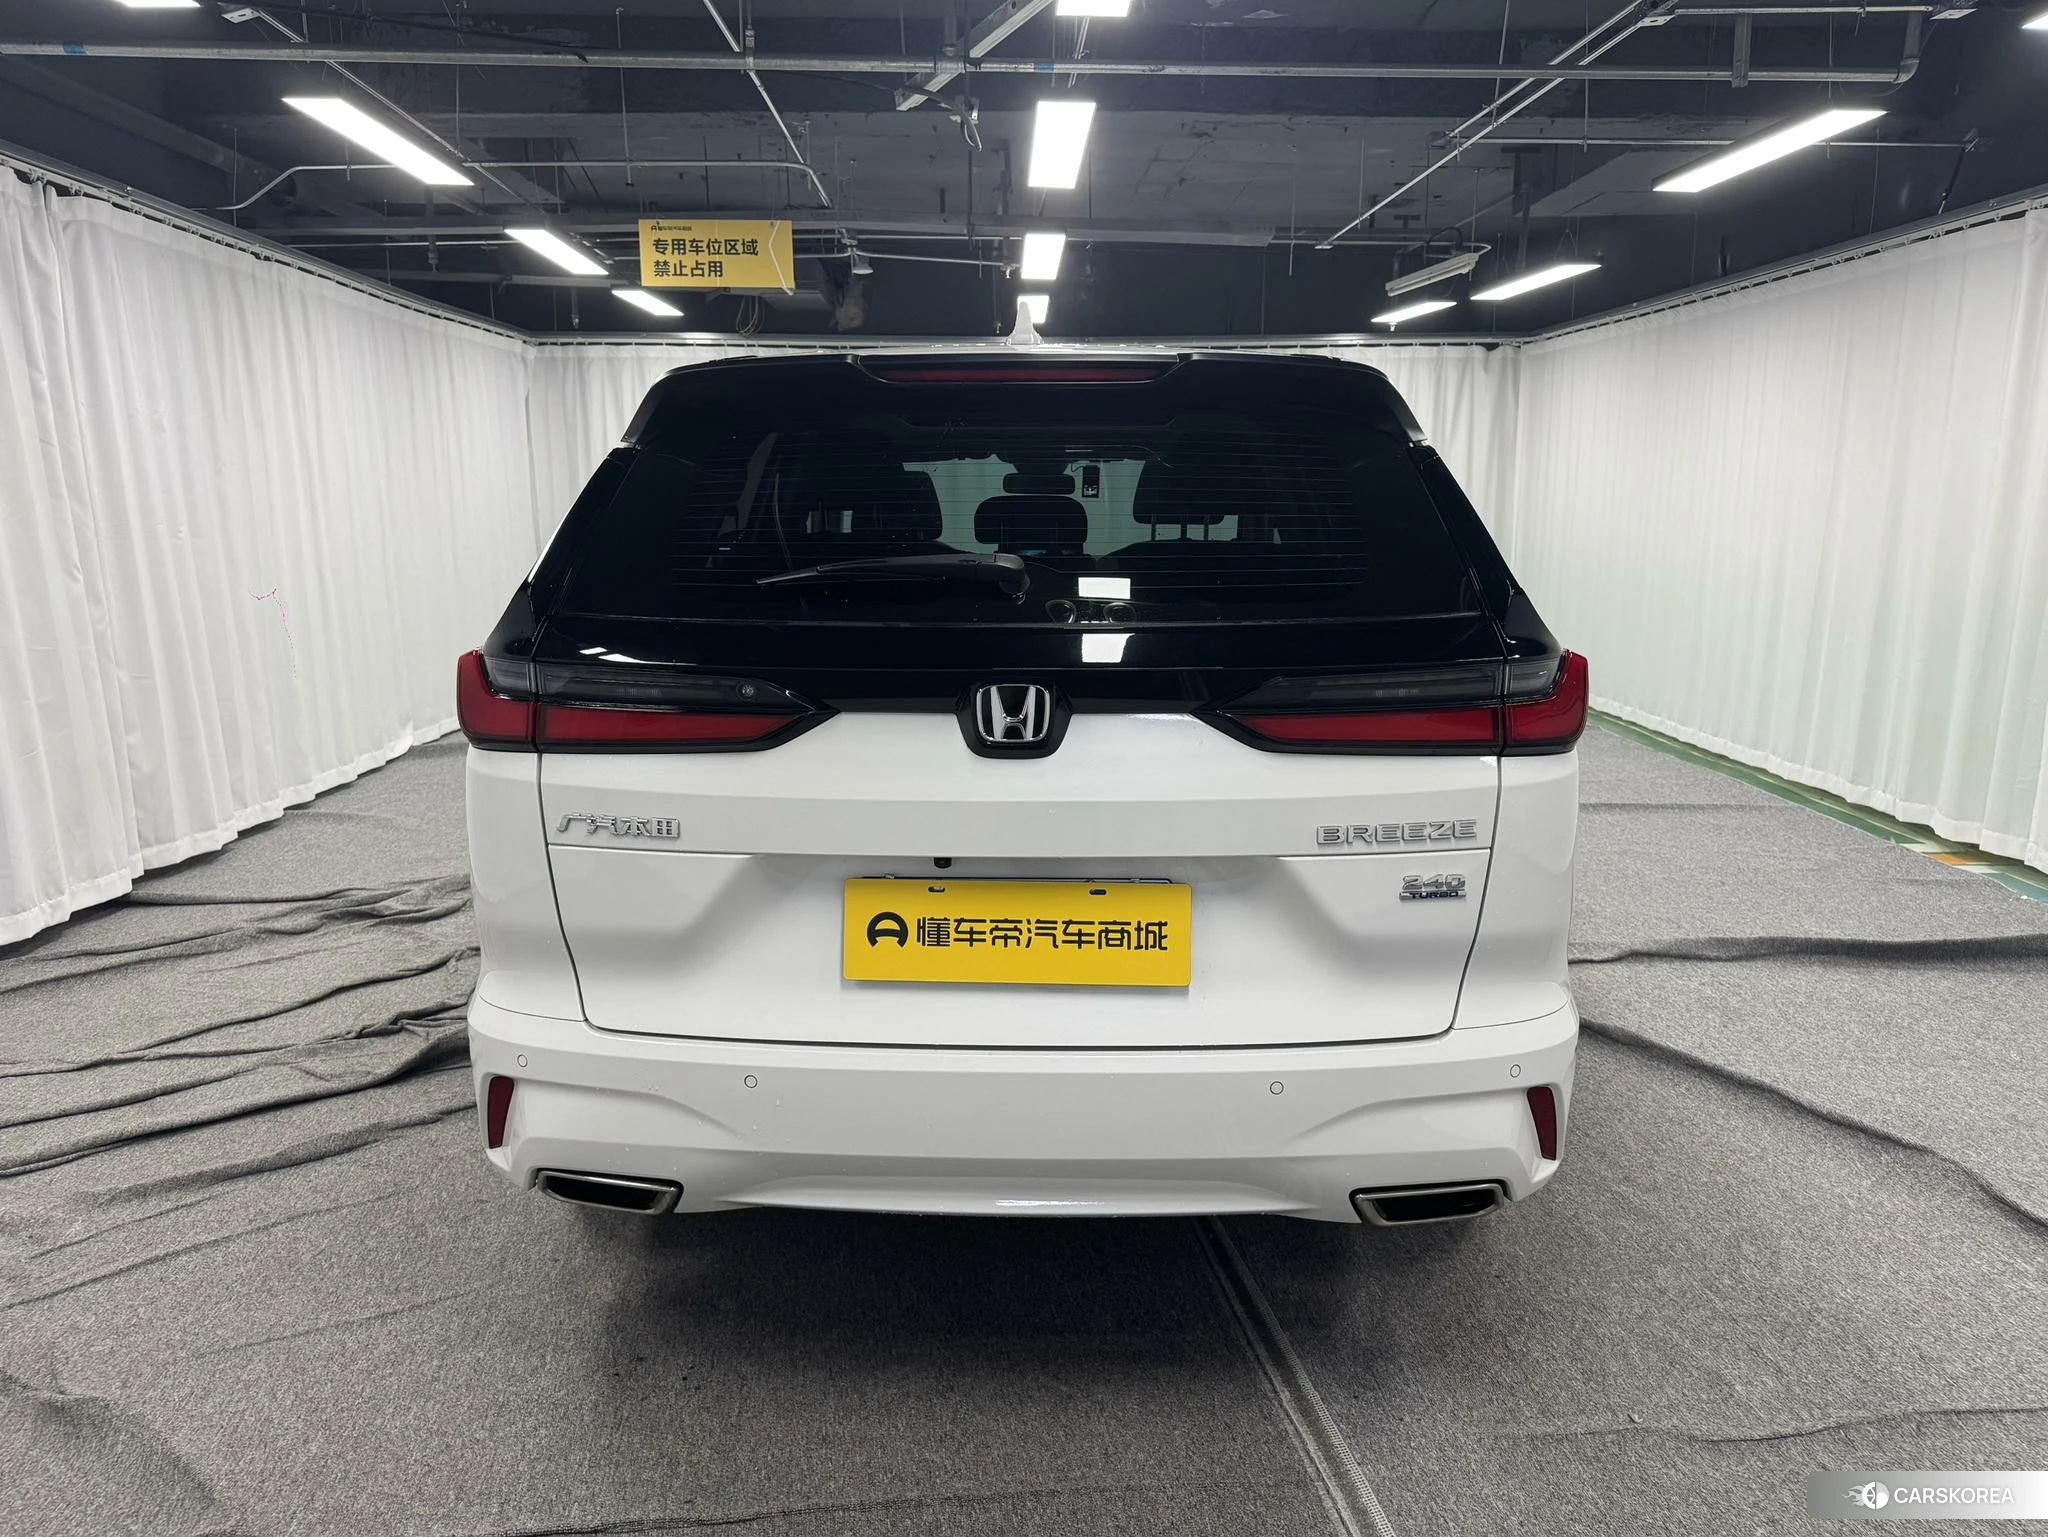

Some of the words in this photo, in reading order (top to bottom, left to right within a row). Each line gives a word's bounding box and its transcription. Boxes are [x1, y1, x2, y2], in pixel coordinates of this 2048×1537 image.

[653, 238, 759, 256] 专用车位区域
[653, 260, 724, 278] 禁止占用
[557, 812, 680, 838] 广汽本田
[1316, 819, 1477, 844] BREEZE
[1402, 873, 1466, 891] 240
[1408, 890, 1460, 899] TURBO
[916, 916, 1169, 951] 懂车帝汽车商城
